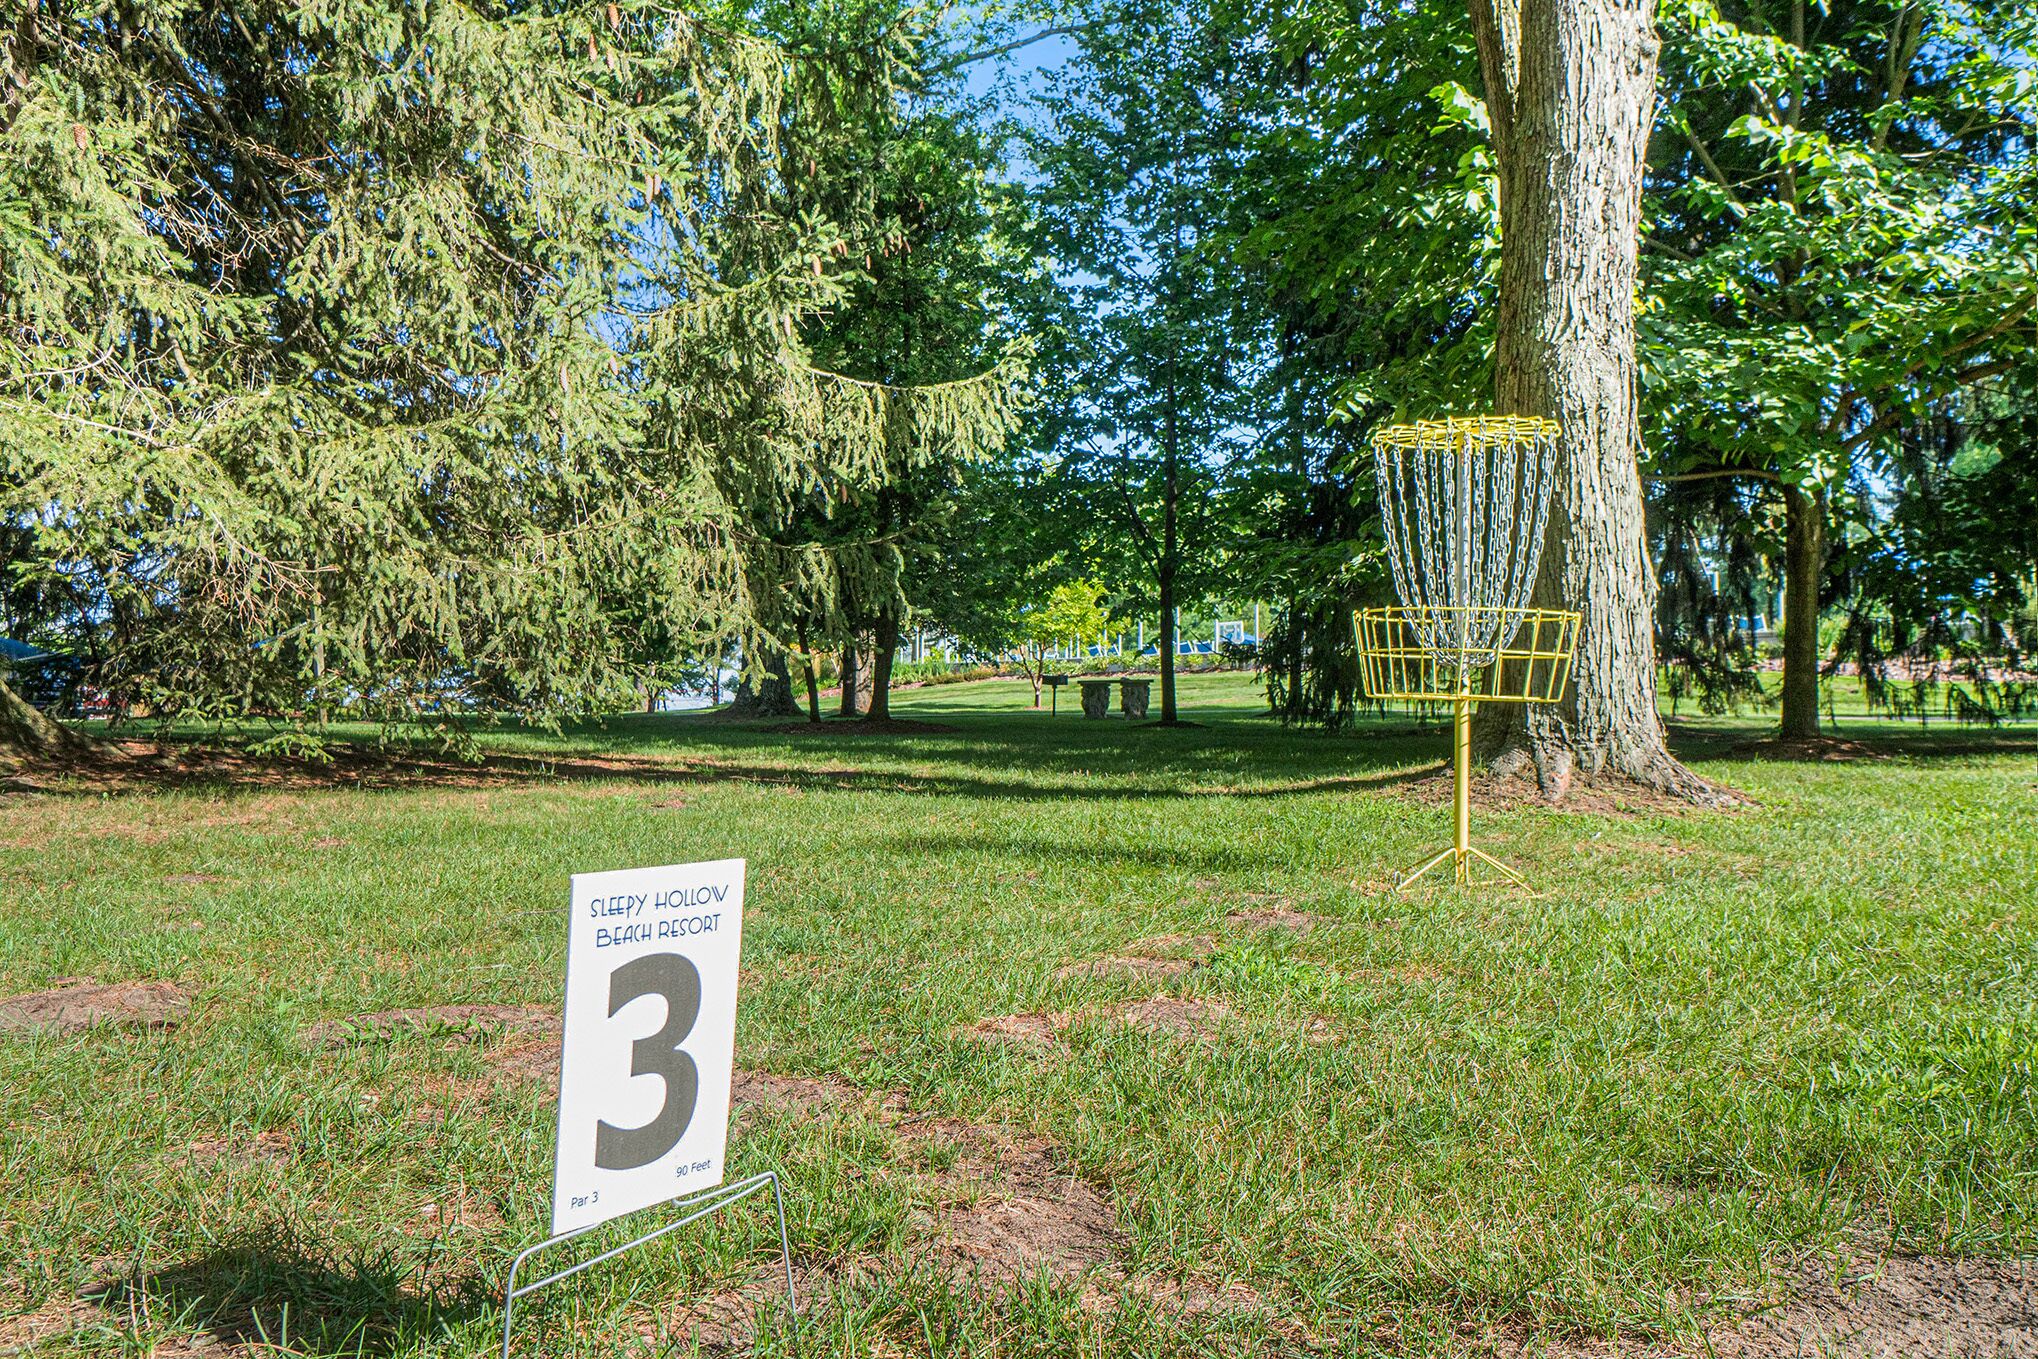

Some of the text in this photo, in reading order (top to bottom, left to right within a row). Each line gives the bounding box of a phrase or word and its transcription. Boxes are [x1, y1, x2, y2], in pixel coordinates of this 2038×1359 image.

[590, 884, 729, 919] SLEEPY HOLLOW
[597, 913, 721, 947] BEACH RESORT
[594, 952, 702, 1170] 3
[675, 1159, 711, 1178] 90 Feet
[570, 1191, 600, 1209] Par 3
